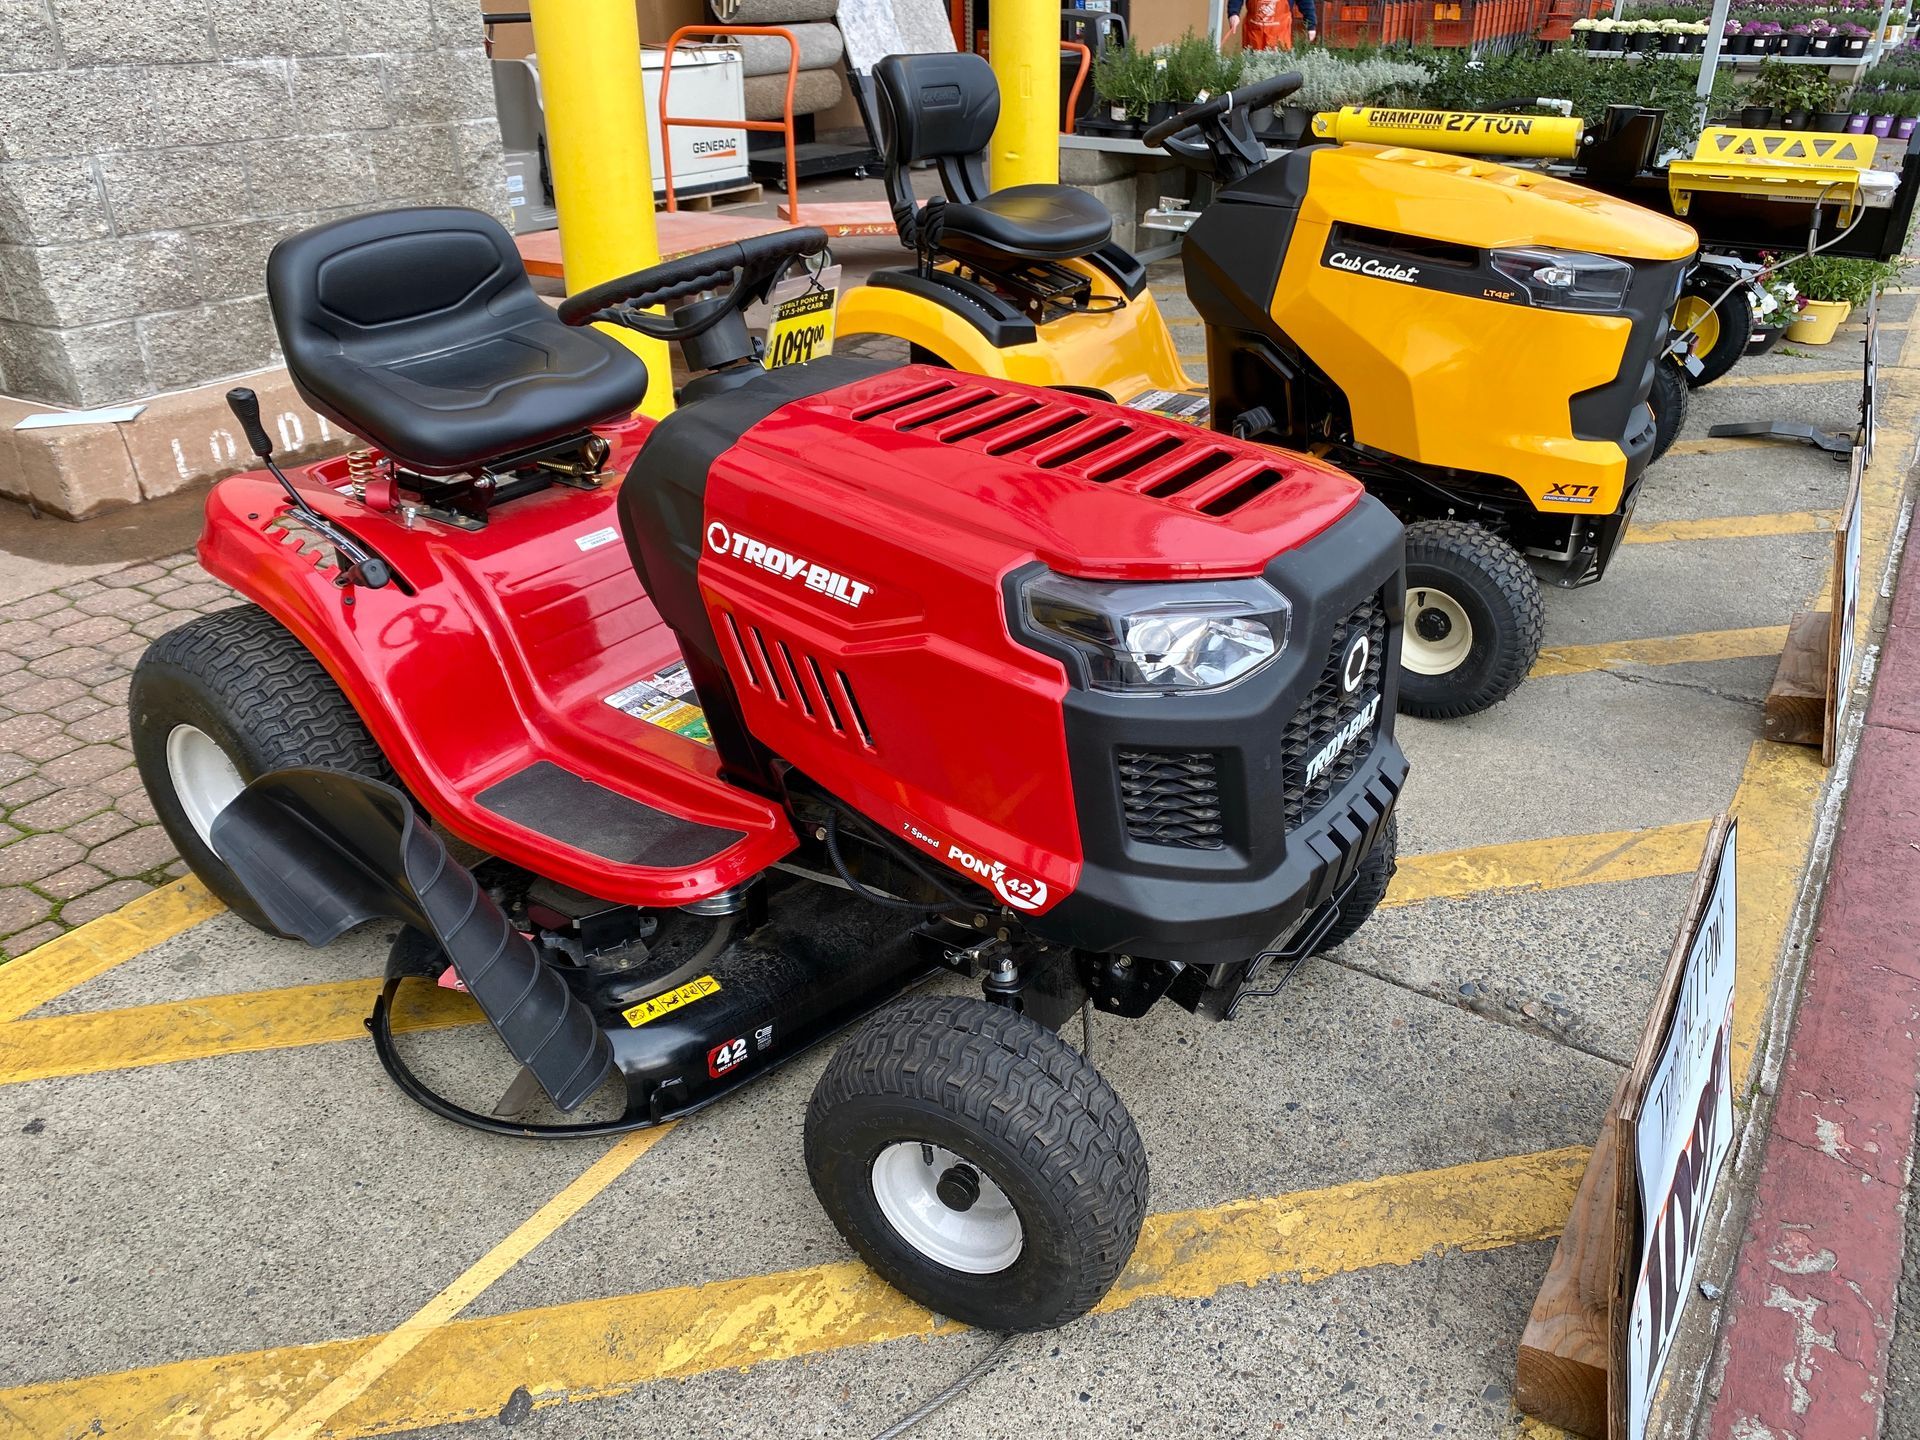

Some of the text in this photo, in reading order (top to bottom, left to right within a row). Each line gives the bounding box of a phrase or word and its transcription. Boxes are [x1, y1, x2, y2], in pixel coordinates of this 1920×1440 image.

[1369, 110, 1444, 125] CHAMPION
[1445, 113, 1481, 132] 27
[1484, 116, 1533, 135] TON
[692, 138, 736, 154] GENERAC
[1328, 252, 1420, 283] Cub Cadet
[781, 305, 806, 317] 17.5-HP
[807, 301, 824, 311] CARB
[800, 295, 819, 306] PONY
[819, 293, 829, 301] 42
[1545, 483, 1600, 497] XT1
[731, 532, 870, 608] TROY-BILT
[1304, 693, 1382, 787] TROY-BILT
[902, 822, 941, 848] 7 Speed
[947, 845, 1034, 898] PONY 42
[716, 1038, 747, 1065] 42
[718, 1054, 748, 1073] INCH DECK
